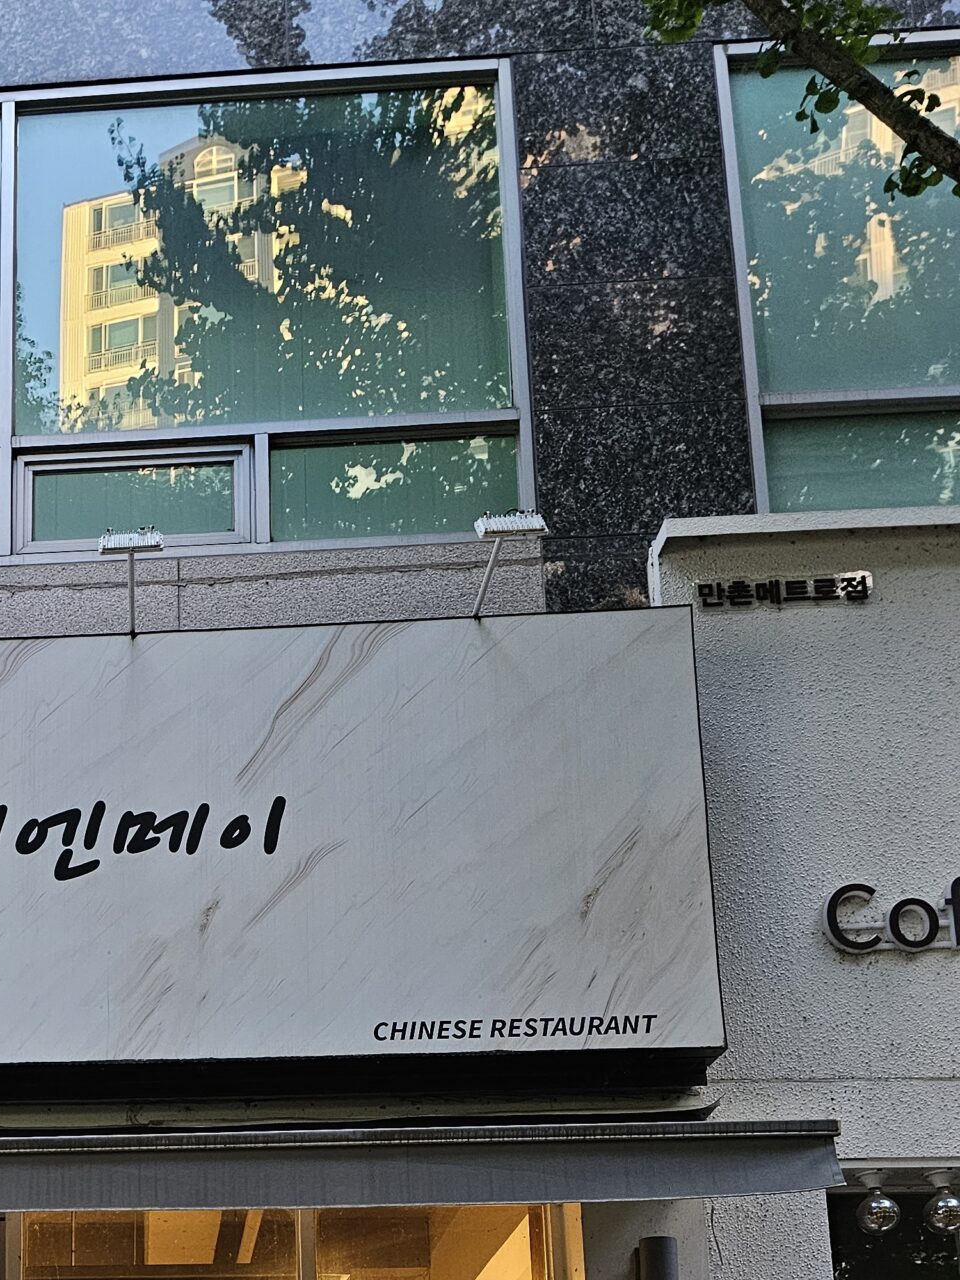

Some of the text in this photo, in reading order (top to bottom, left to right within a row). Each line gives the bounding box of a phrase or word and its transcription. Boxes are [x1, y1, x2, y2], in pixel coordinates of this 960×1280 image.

[697, 574, 870, 608] 만촌메트로점
[373, 1014, 658, 1042] CHINESE RESTAURANT
